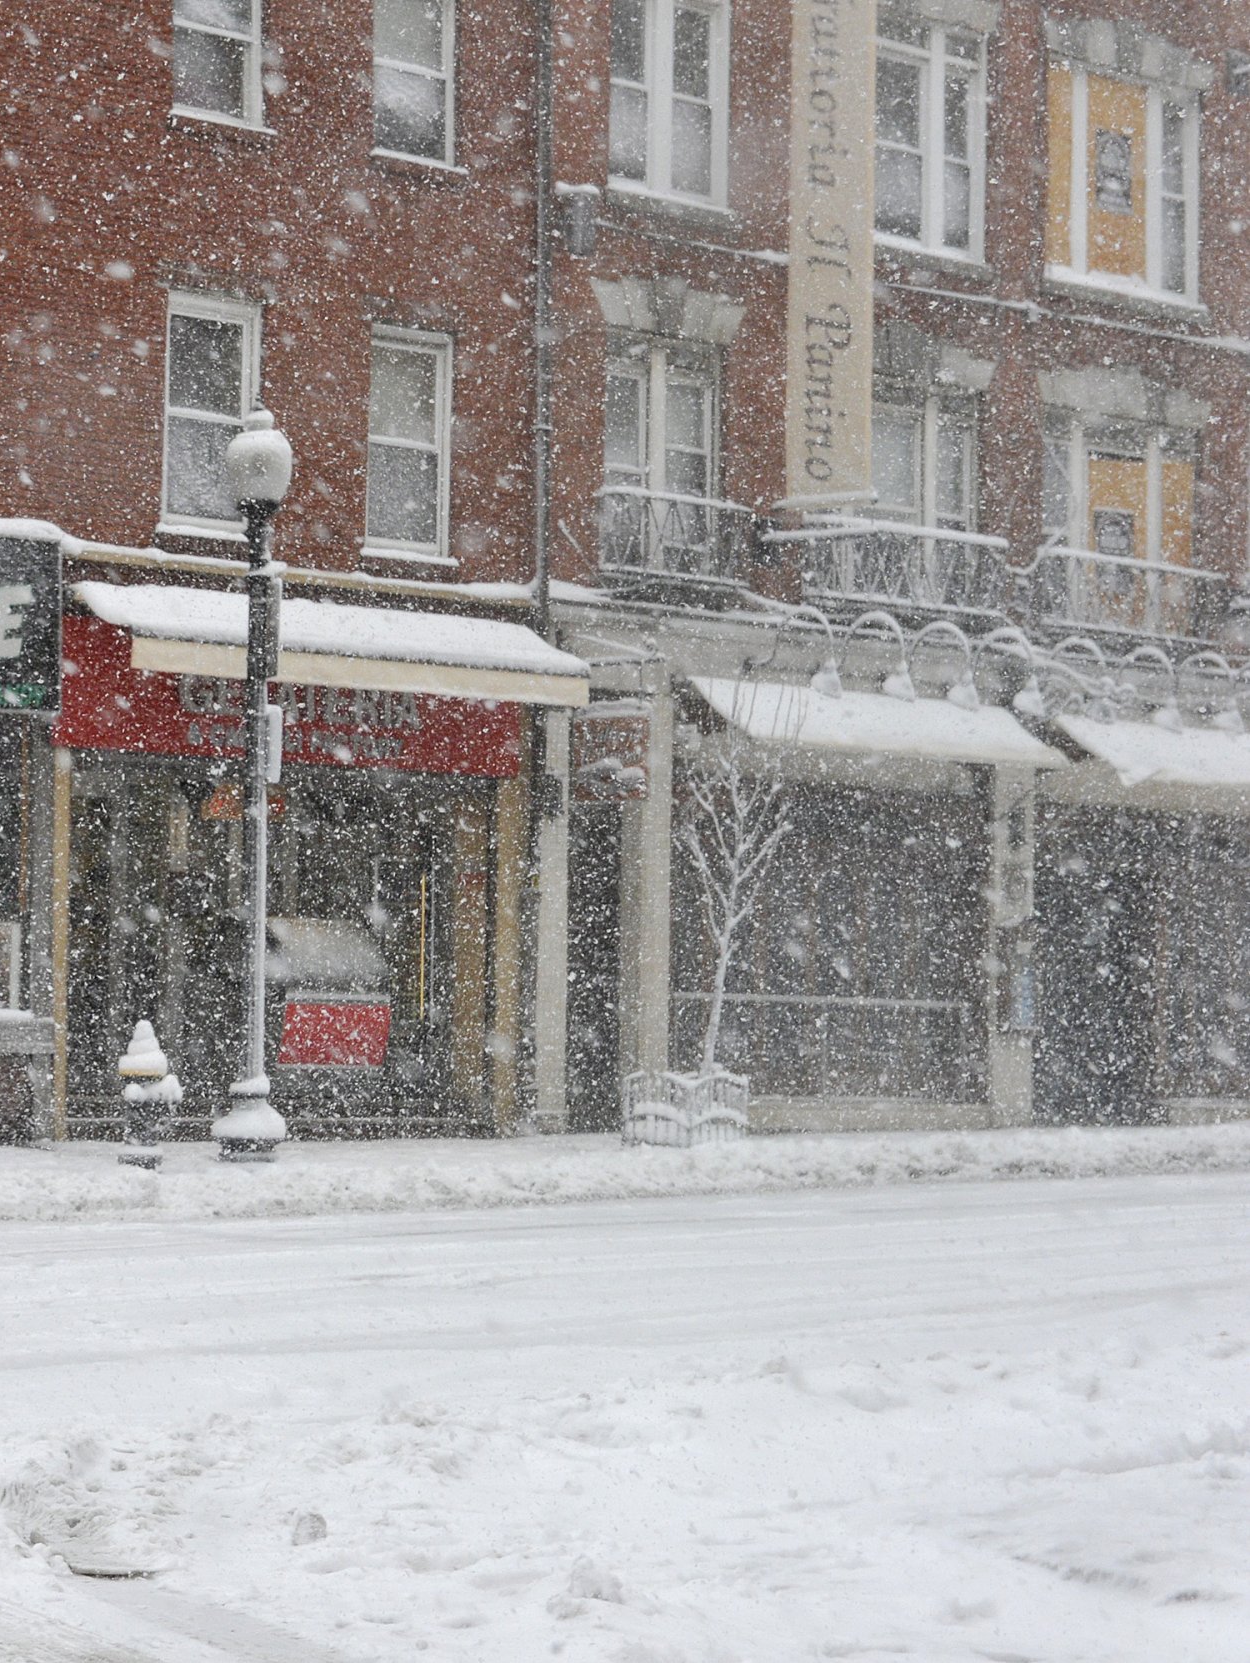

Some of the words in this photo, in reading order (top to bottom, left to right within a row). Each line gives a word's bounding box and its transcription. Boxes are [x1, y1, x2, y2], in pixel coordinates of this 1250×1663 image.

[806, 216, 852, 278] Il
[803, 303, 852, 482] Panino
[179, 675, 425, 729] GEATERIA
